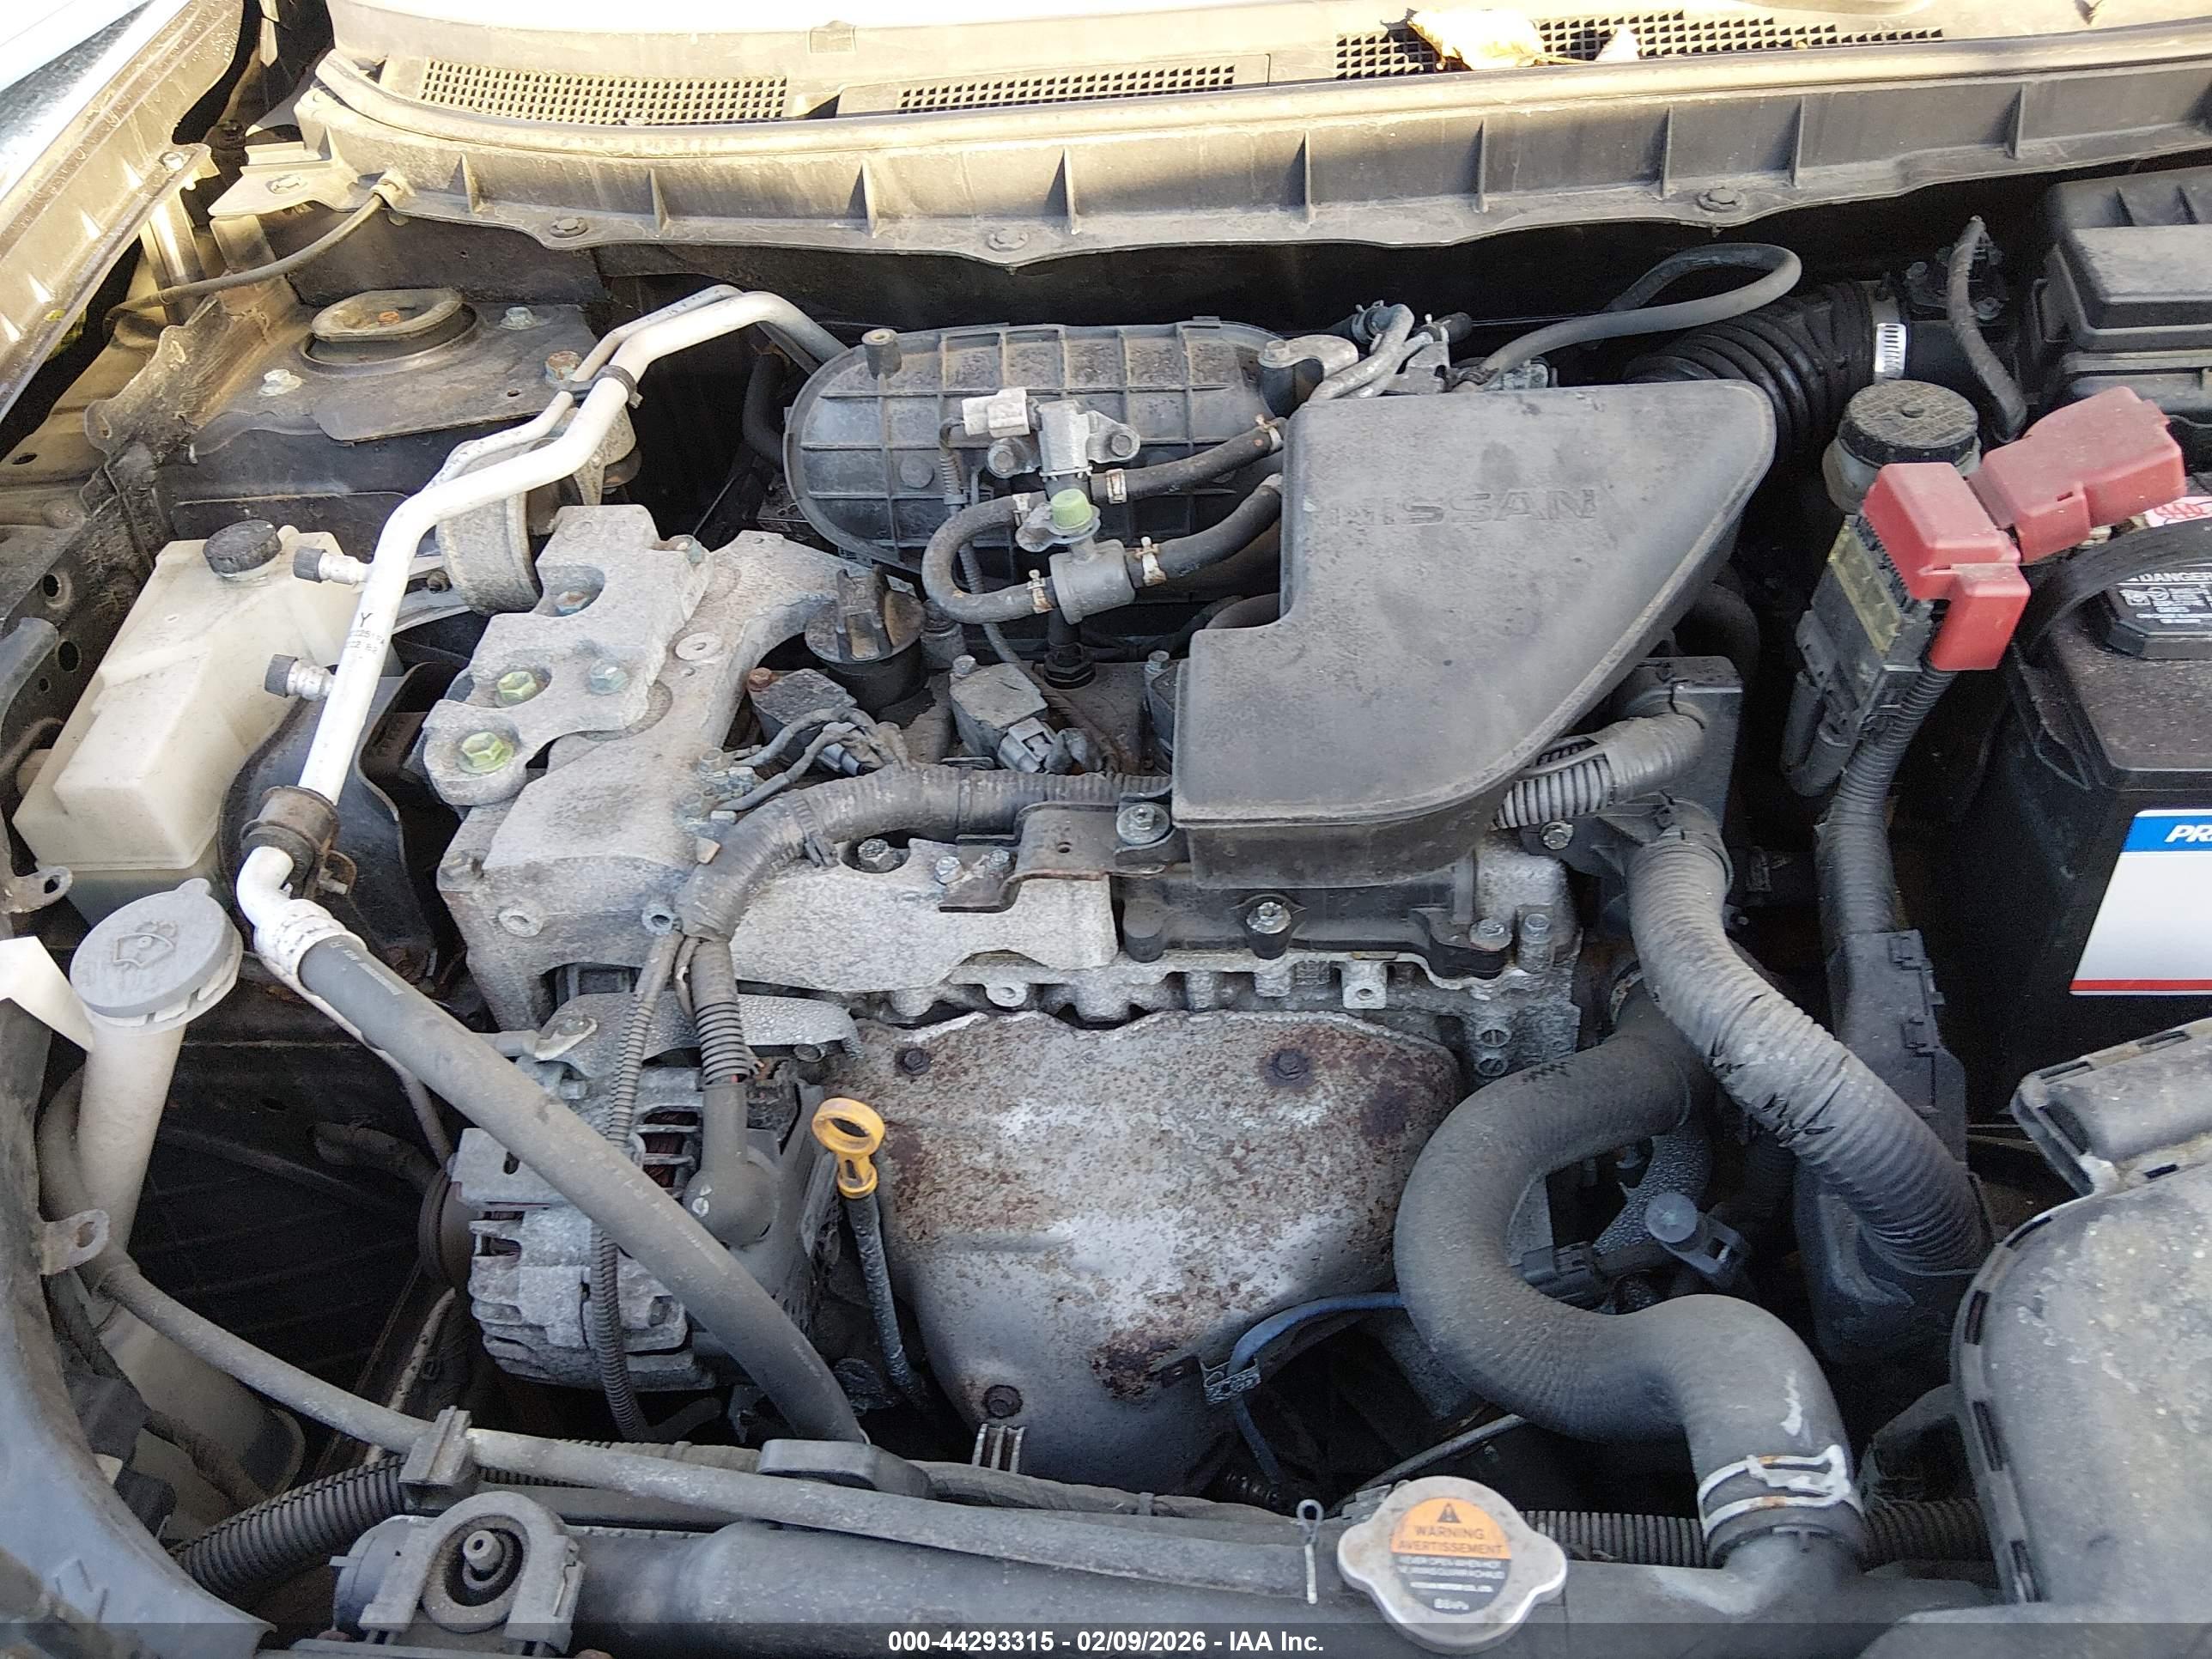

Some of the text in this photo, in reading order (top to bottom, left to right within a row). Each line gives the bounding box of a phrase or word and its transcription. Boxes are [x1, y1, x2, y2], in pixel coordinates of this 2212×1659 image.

[361, 612, 374, 628] Y
[1415, 1525, 1485, 1540] WARNING
[1398, 1540, 1504, 1554] AVERTISSEMENT
